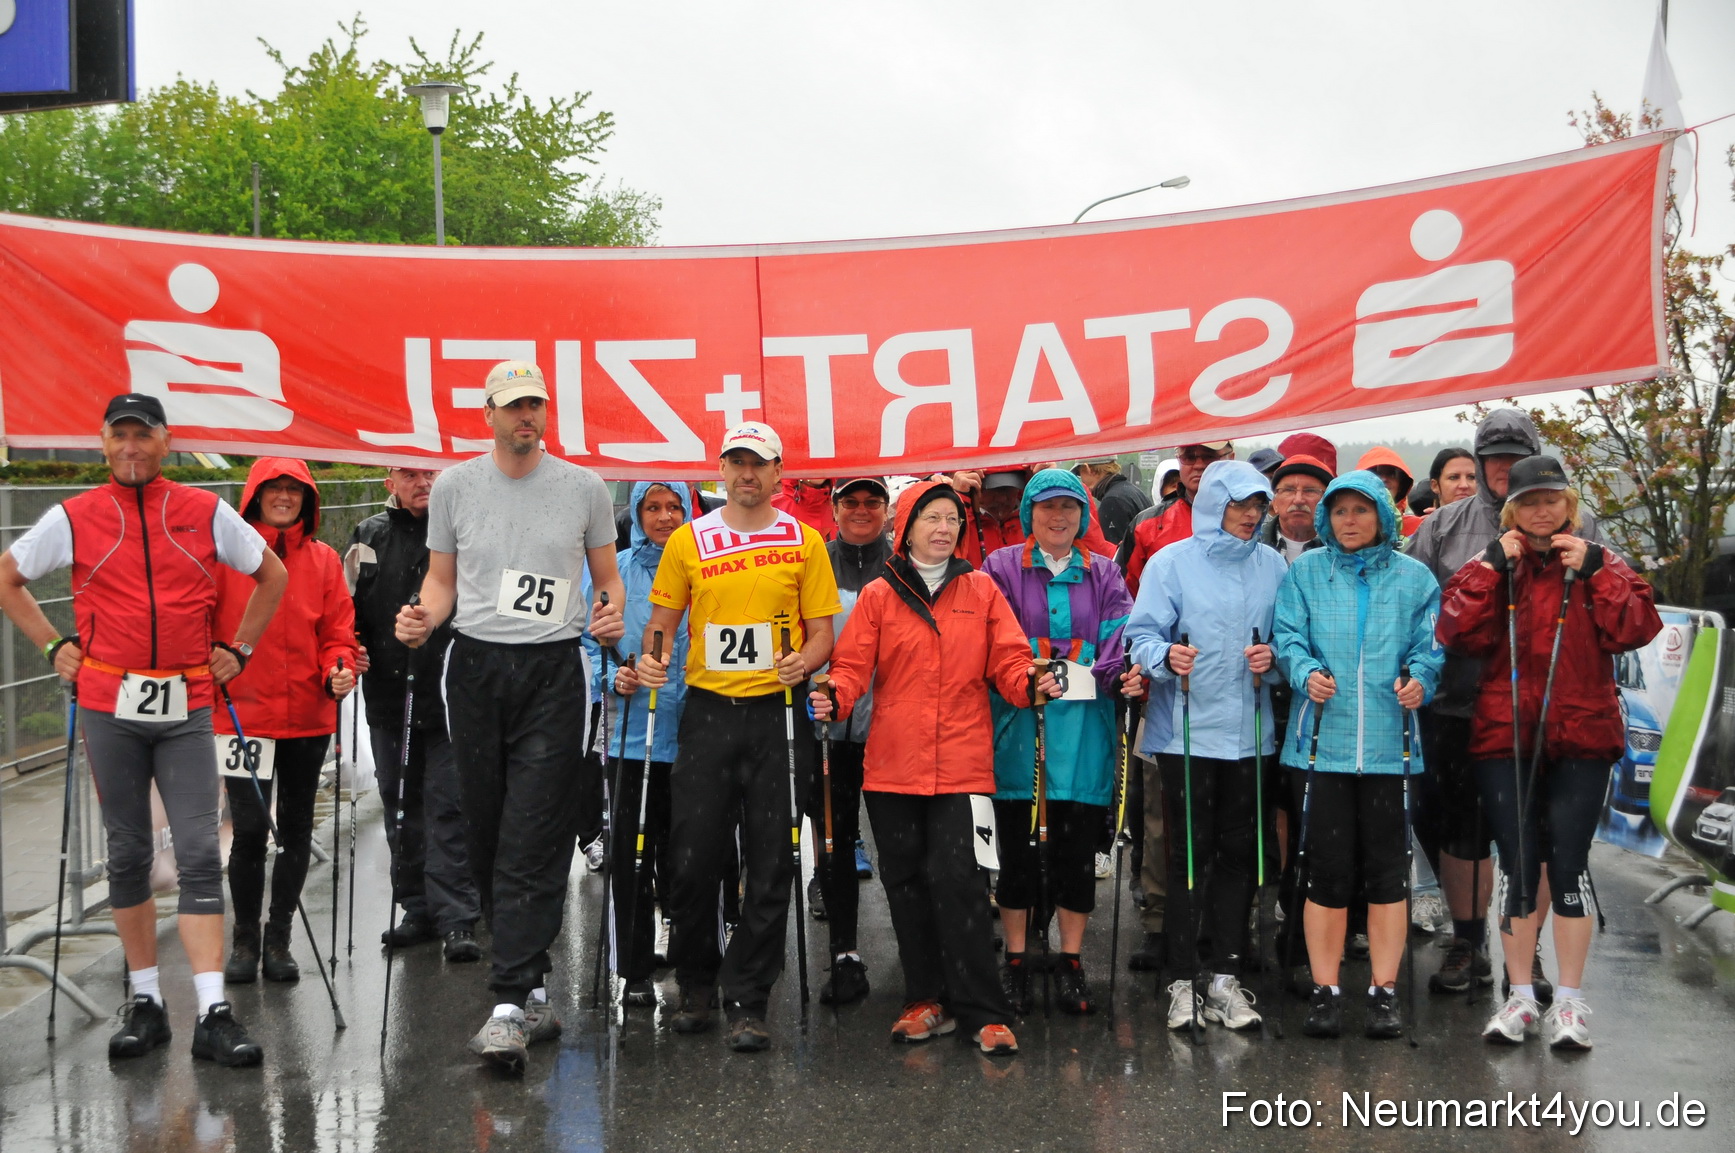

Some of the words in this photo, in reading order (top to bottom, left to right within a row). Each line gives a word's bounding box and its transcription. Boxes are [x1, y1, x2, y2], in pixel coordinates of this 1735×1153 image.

[701, 558, 748, 580] MAX
[755, 549, 805, 568] BÖGL
[513, 574, 556, 616] 25
[720, 627, 758, 664] 24
[137, 679, 171, 715] 21
[225, 737, 262, 772] 38
[976, 825, 992, 846] 4
